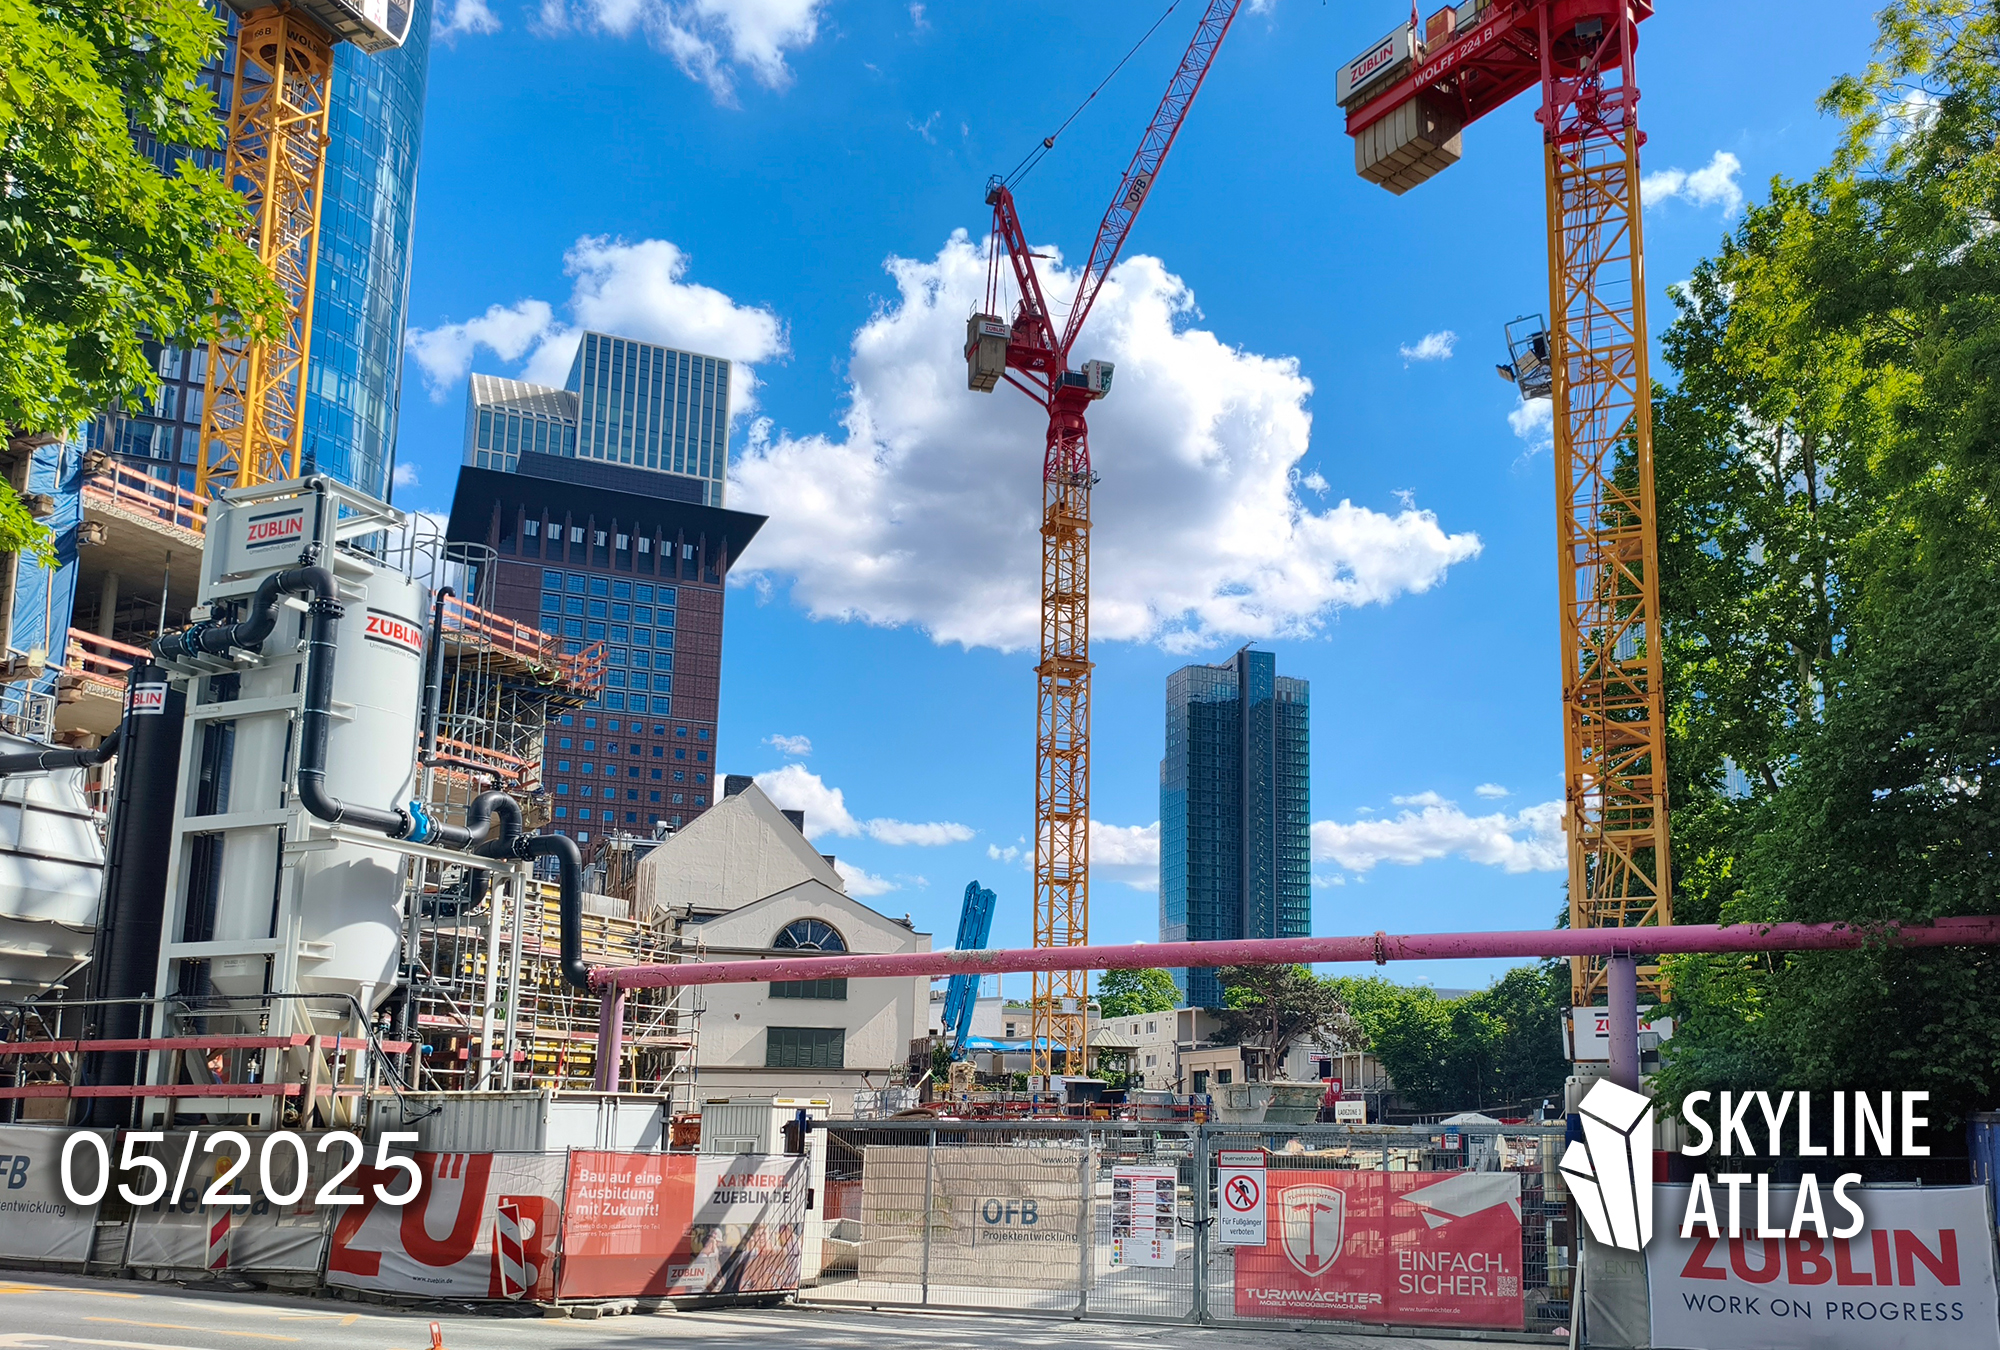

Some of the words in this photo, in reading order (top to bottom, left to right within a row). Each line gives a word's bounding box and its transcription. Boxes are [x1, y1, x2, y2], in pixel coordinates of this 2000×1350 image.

[1351, 43, 1393, 84] ZÜBLIN
[1414, 54, 1455, 88] WOLFF
[1460, 35, 1481, 58] 224
[1484, 27, 1493, 42] B
[1129, 179, 1146, 202] OFB
[247, 516, 303, 541] ZÜBLIN
[365, 616, 422, 649] ZÜBLIN
[125, 692, 162, 706] BLIN
[580, 1169, 605, 1183] Bau
[610, 1171, 631, 1184] auf
[635, 1171, 662, 1184] eine
[578, 1186, 654, 1202] Ausbildung
[713, 1191, 790, 1204] ZUEBLIN.DE
[576, 1202, 598, 1215] mit
[602, 1203, 659, 1217] Zukunft!
[982, 1198, 1039, 1225] OFB
[1222, 1217, 1231, 1225] Für
[1232, 1217, 1262, 1227] Fußgänger
[982, 1231, 1078, 1243] Projektentwicklung
[1399, 1250, 1509, 1273] EINFACH.
[1678, 1224, 1961, 1287] ZÜBLIN
[1399, 1274, 1493, 1296] SICHER.
[1245, 1288, 1382, 1305] TURMWÄCHTER
[1288, 1300, 1367, 1311] VIDEOÜBERWACHUNG
[1682, 1292, 1761, 1316] WORK
[1770, 1298, 1812, 1320] ON
[1826, 1301, 1964, 1321] PROGRESS
